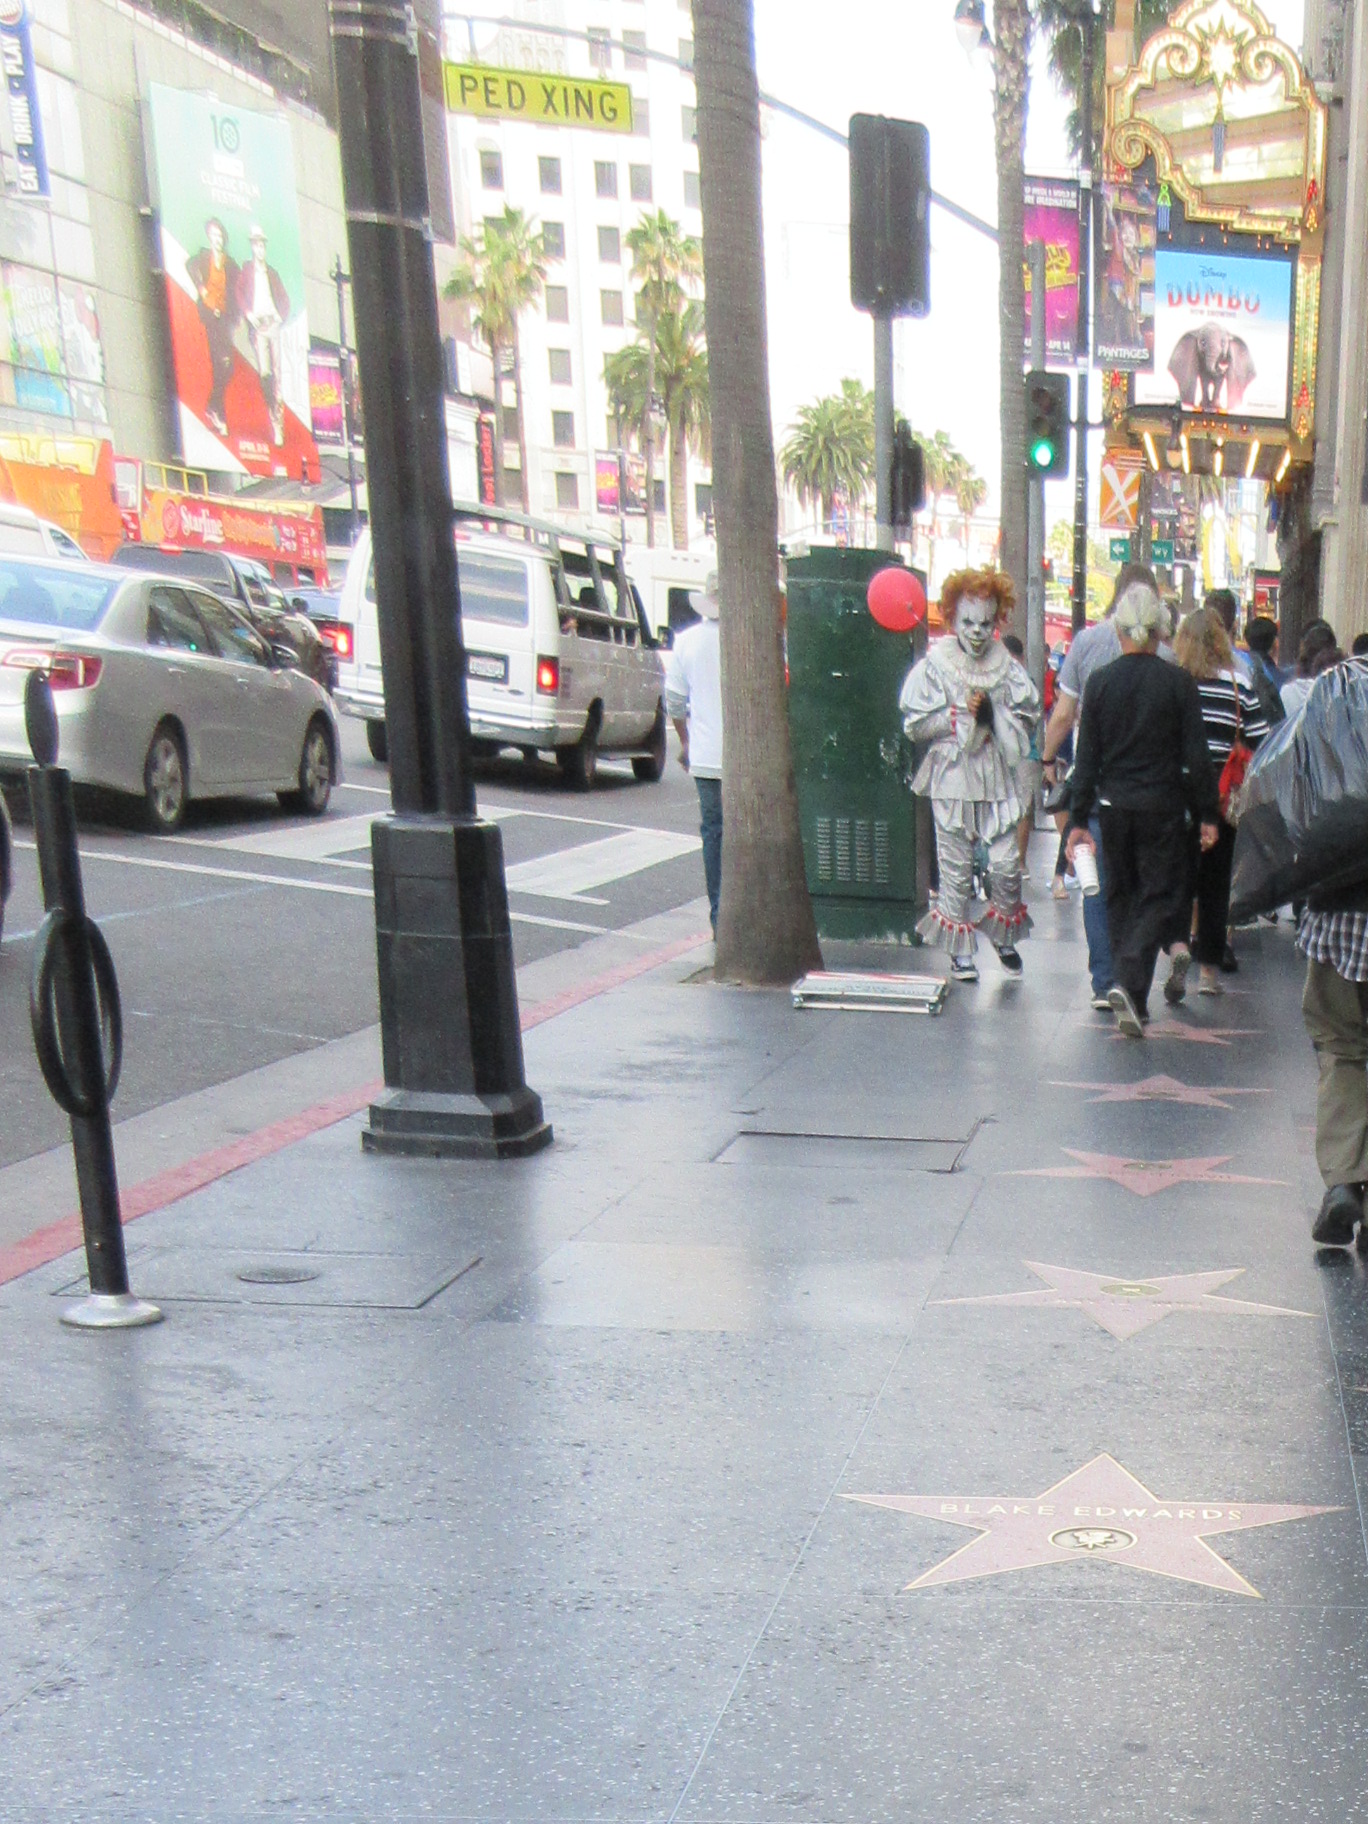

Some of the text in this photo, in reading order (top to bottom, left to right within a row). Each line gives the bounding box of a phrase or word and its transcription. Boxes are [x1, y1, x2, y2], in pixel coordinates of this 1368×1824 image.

[1, 35, 39, 192] EAT DRINK PLAY
[460, 74, 618, 123] PED XING
[1167, 282, 1260, 314] DUMBO
[1098, 345, 1150, 360] PANTAGES
[940, 1504, 1243, 1521] BLAKE EDWARDS
